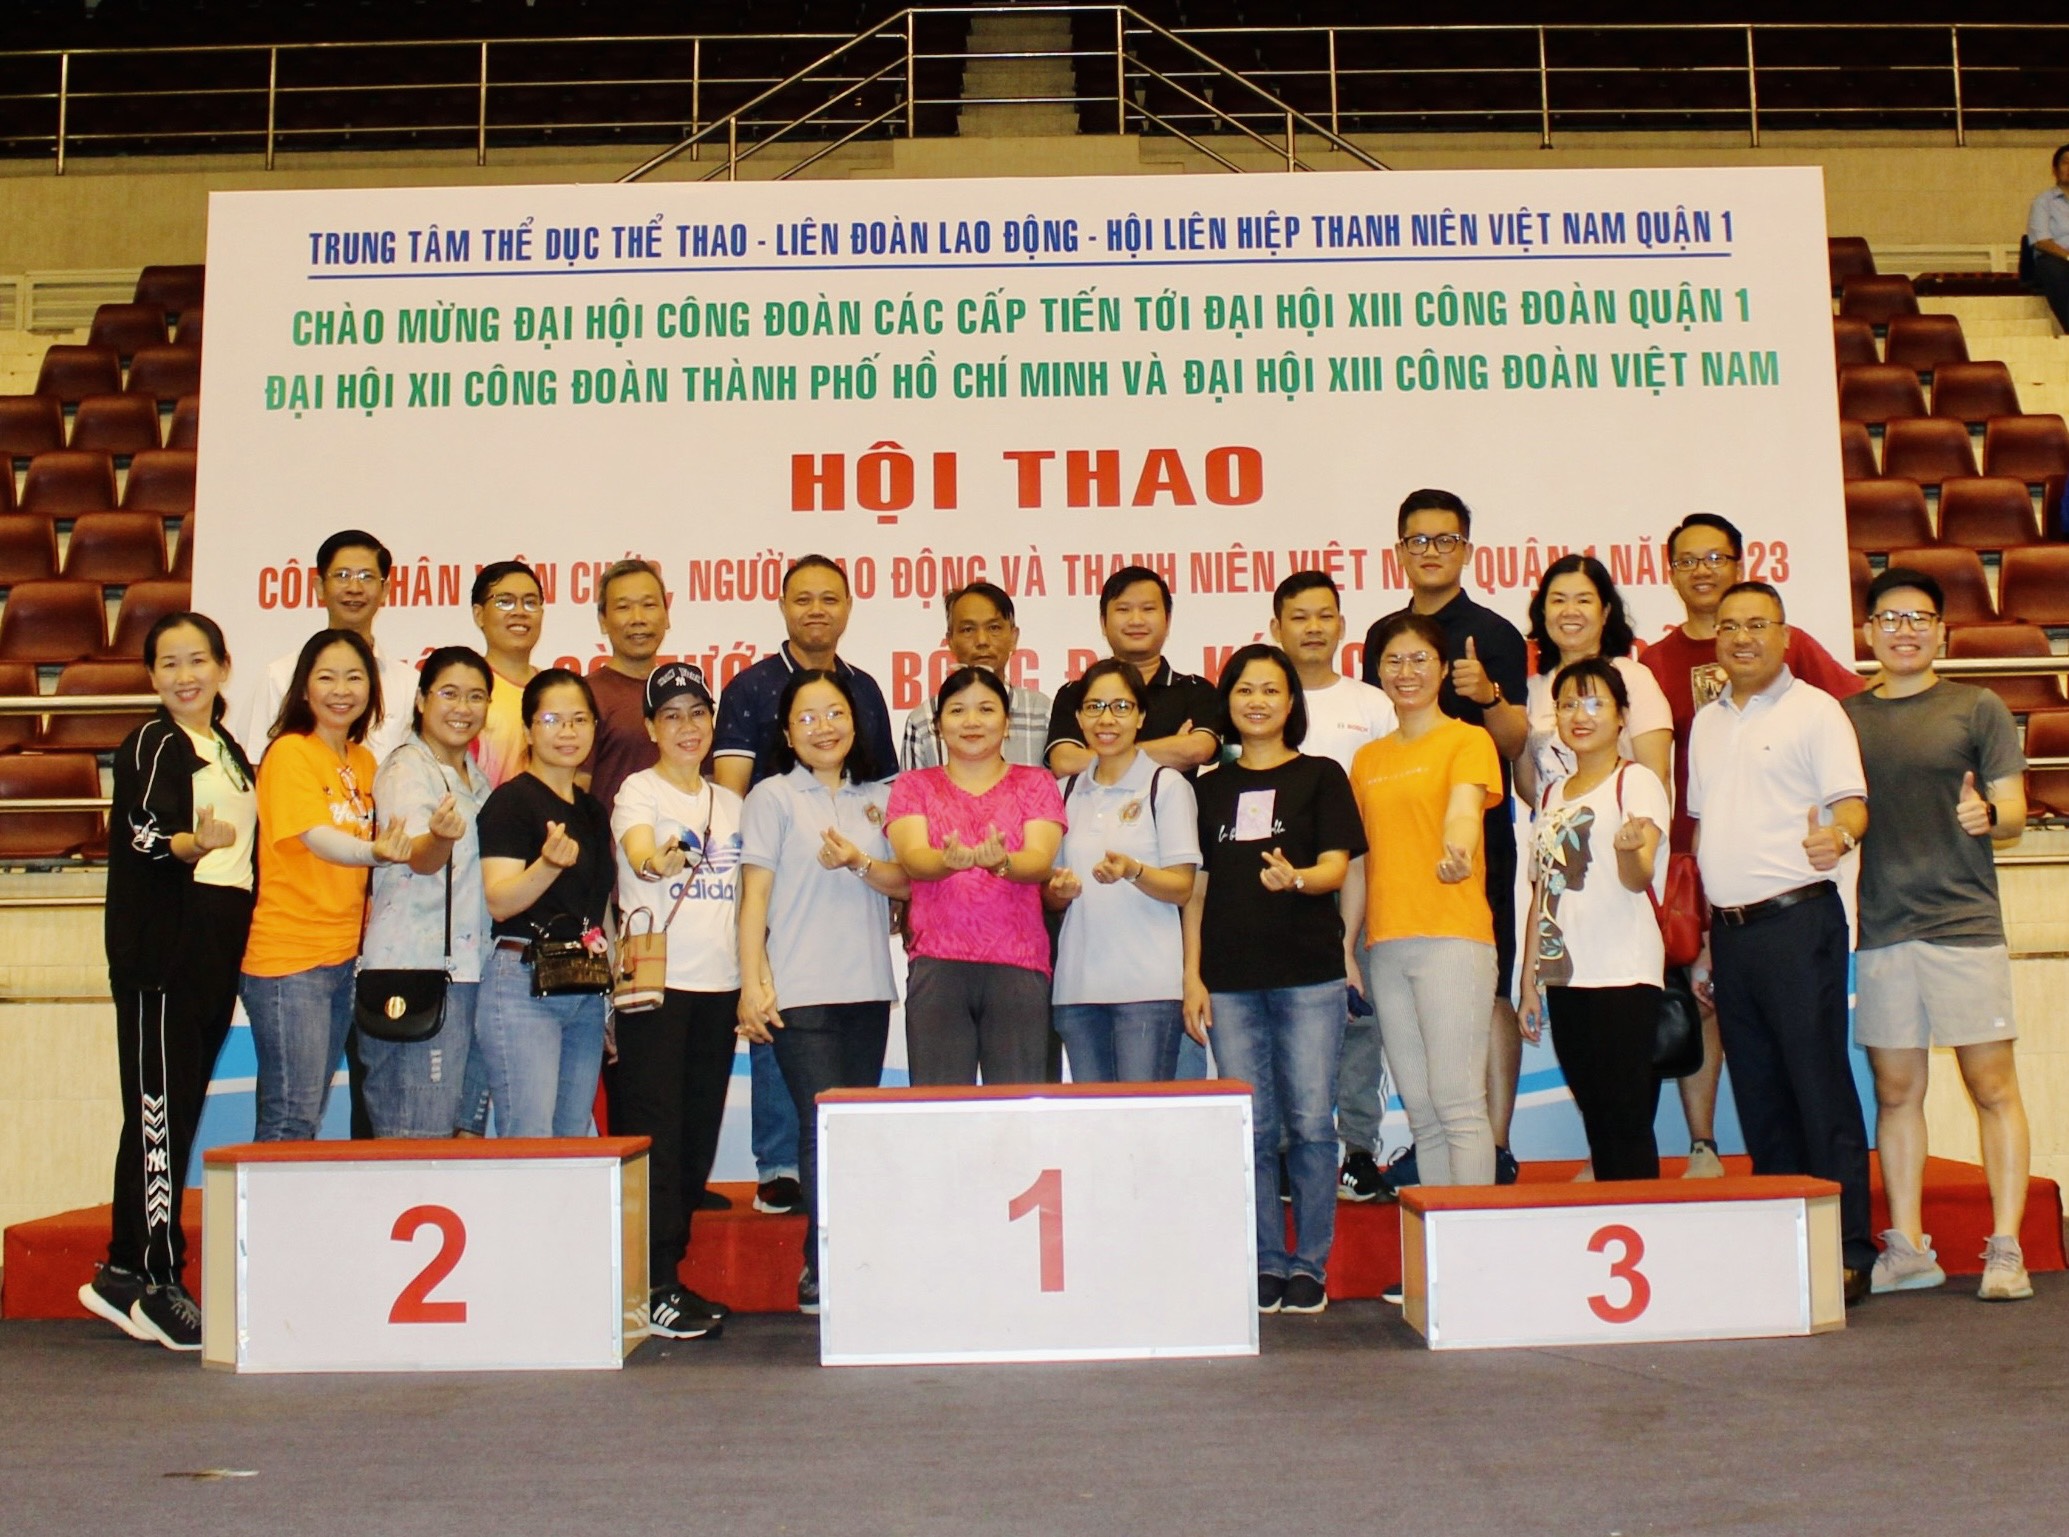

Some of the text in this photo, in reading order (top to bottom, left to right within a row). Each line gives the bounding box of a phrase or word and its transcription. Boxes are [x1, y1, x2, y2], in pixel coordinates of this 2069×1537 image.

[309, 231, 396, 265] TRUNG
[408, 224, 470, 263] TÂM
[482, 216, 534, 261] THỂ
[546, 227, 599, 267] DỤC
[611, 213, 663, 258] THỂ
[676, 224, 747, 257] THAO
[777, 217, 838, 256] LIÊN
[850, 215, 928, 255] ĐOÀN
[940, 219, 990, 254] LAO
[1003, 214, 1078, 259] ĐỘNG
[1107, 212, 1152, 259] HỘI
[1164, 211, 1226, 250] LIÊN
[1237, 210, 1300, 256] HIỆP
[1311, 215, 1400, 248] THANH
[1411, 208, 1477, 246] NIÊN
[1489, 207, 1551, 252] VIỆT
[1563, 212, 1625, 244] NAM
[1637, 205, 1711, 250] QUẬN
[1721, 211, 1732, 242] 1
[293, 281, 1749, 350] CHÀO MỪNG ĐẠI HỘI CÔNG ĐOÀN CÁC CẤP TIẾN TỚI ĐẠI HỘI XIII CÔNG ĐOÀN QUẬN 1
[265, 345, 1779, 419] ĐẠI HỘI XII CÔNG ĐOÀN THÀNH PHỐ HỒ CHÍ MINH VÀ ĐẠI HỘI XIII CÔNG ĐOÀN VIỆT NAM
[792, 440, 1264, 525] HỘI THAO
[379, 556, 461, 607] HÂN
[891, 547, 987, 609] ĐỘNG
[1000, 544, 1047, 597] VÀ
[1190, 542, 1276, 594] NIÊN
[388, 1204, 467, 1324] 2
[1009, 1169, 1064, 1292] 1
[1586, 1223, 1651, 1324] 3
